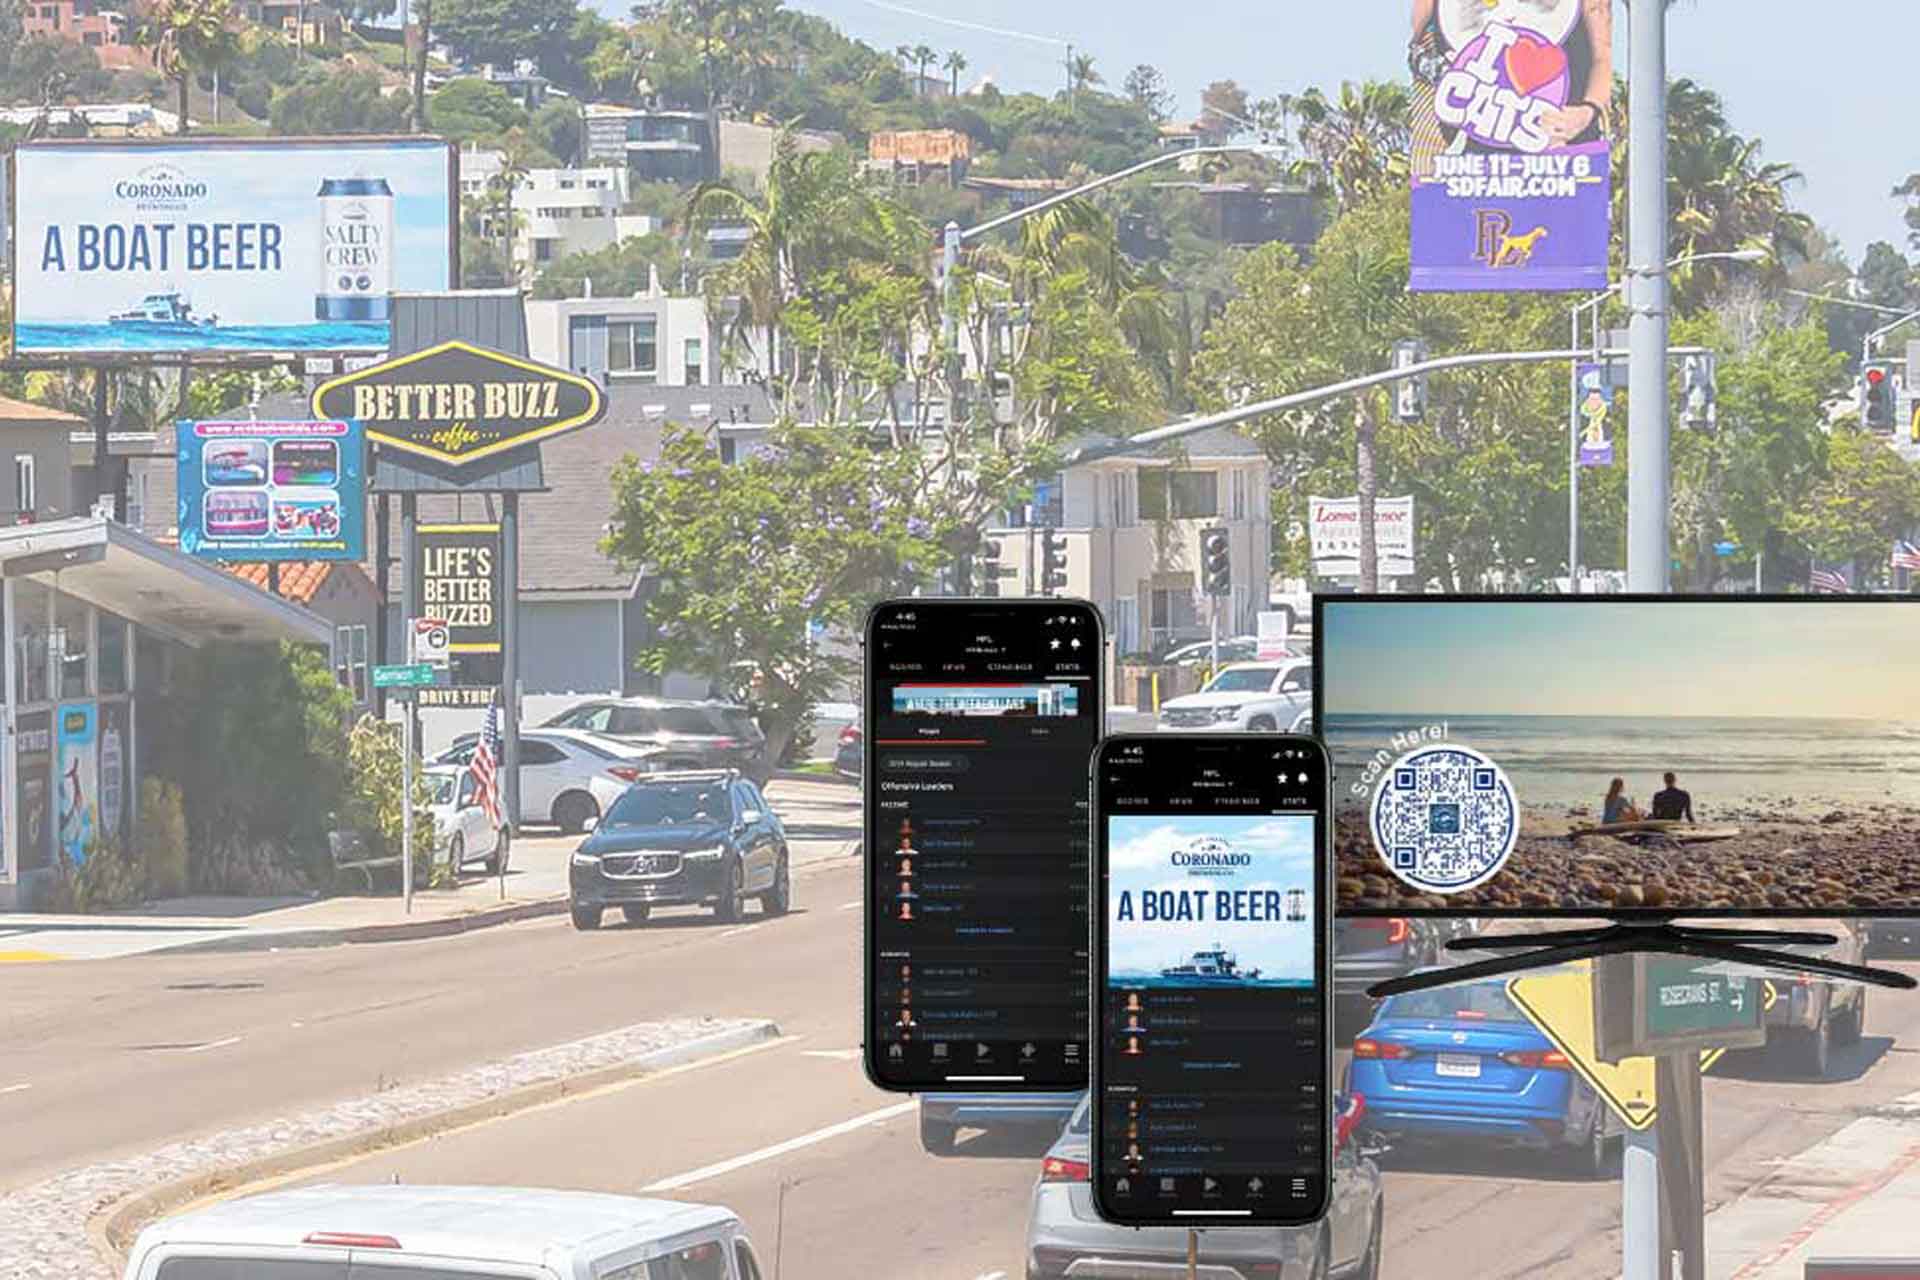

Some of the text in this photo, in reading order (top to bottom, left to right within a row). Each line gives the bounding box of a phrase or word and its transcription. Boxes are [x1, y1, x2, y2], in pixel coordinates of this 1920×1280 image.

[1465, 23, 1518, 83] I
[1435, 71, 1561, 151] CATS
[1434, 154, 1485, 176] JUNE
[1573, 155, 1590, 176] 6
[116, 181, 207, 198] CORONADO
[1447, 177, 1576, 197] SDFAIR.COM
[325, 224, 383, 244] SALTY
[42, 223, 282, 271] A BOAT BEER
[326, 247, 378, 265] CREW
[354, 382, 560, 420] BETTER BUZZ
[432, 422, 480, 450] coffee
[424, 548, 492, 576] LIFE'S
[424, 579, 491, 602] BETTER
[425, 604, 492, 626] BUZZED
[418, 690, 459, 704] DRIVE
[1351, 721, 1449, 797] Scan Here!
[1171, 851, 1251, 866] CORONADO
[1118, 890, 1280, 921] A BOAT BEER
